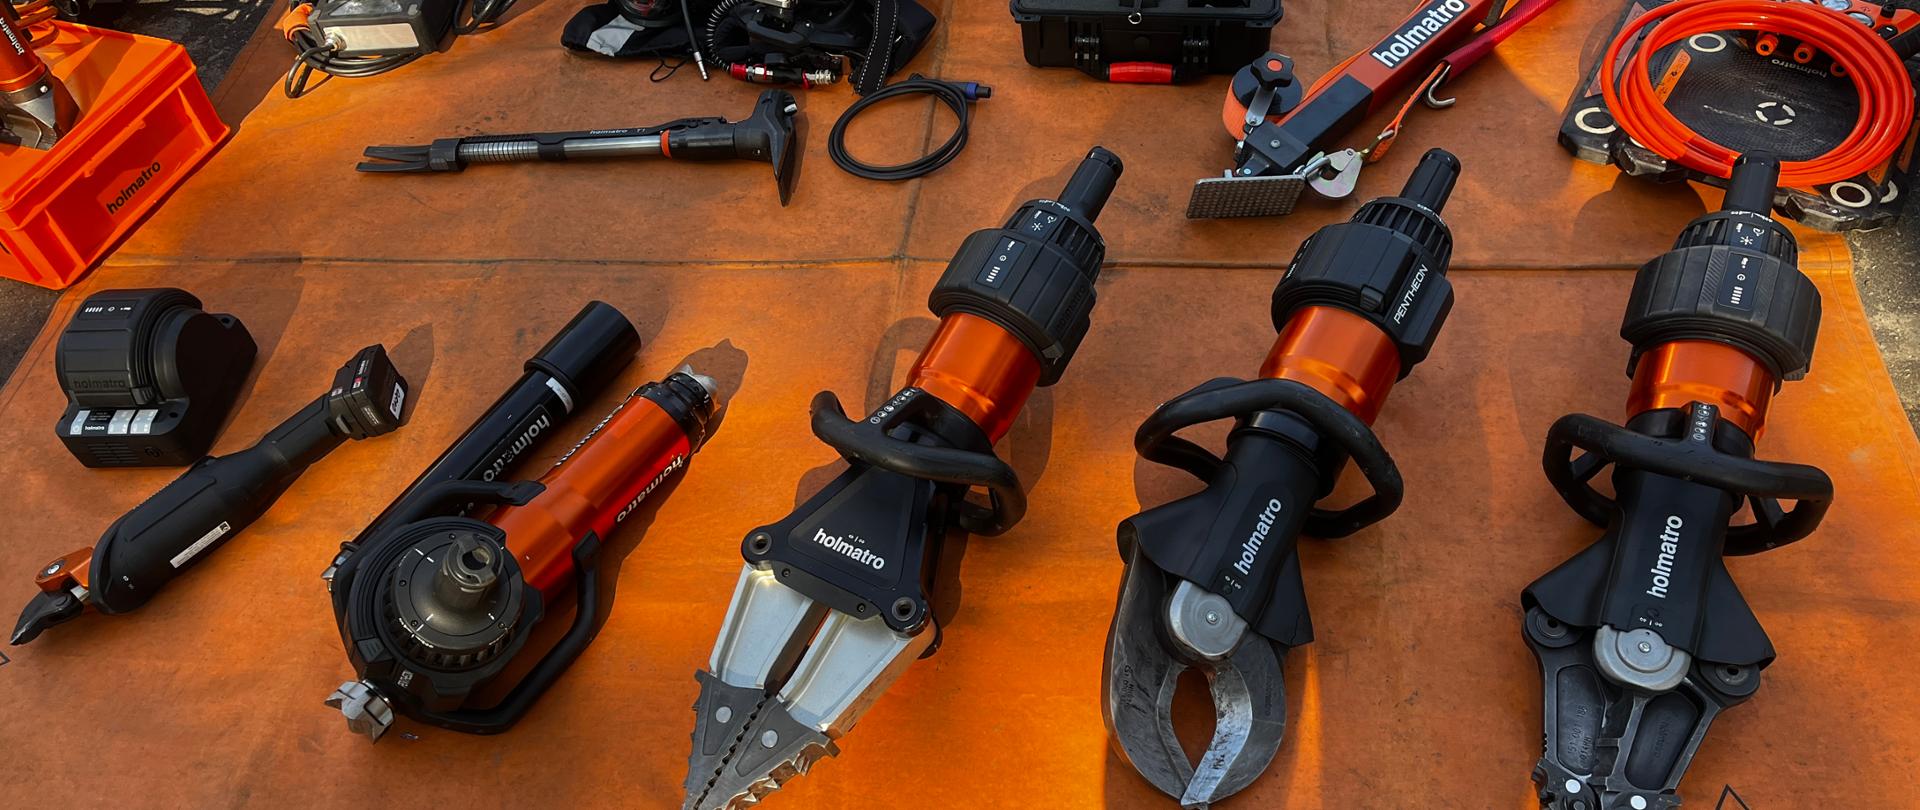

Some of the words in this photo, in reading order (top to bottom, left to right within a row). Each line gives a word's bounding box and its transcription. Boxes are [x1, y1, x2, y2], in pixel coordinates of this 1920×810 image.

[1371, 0, 1465, 67] holmatro
[1771, 58, 1828, 78] holmatro
[106, 161, 161, 215] holmatro
[1393, 263, 1429, 325] PENTHEON
[483, 414, 551, 482] holmatro
[616, 454, 684, 523] holmatro
[812, 527, 885, 570] holmatro
[1233, 498, 1282, 576] holmatro
[1646, 515, 1683, 599] holmatro
